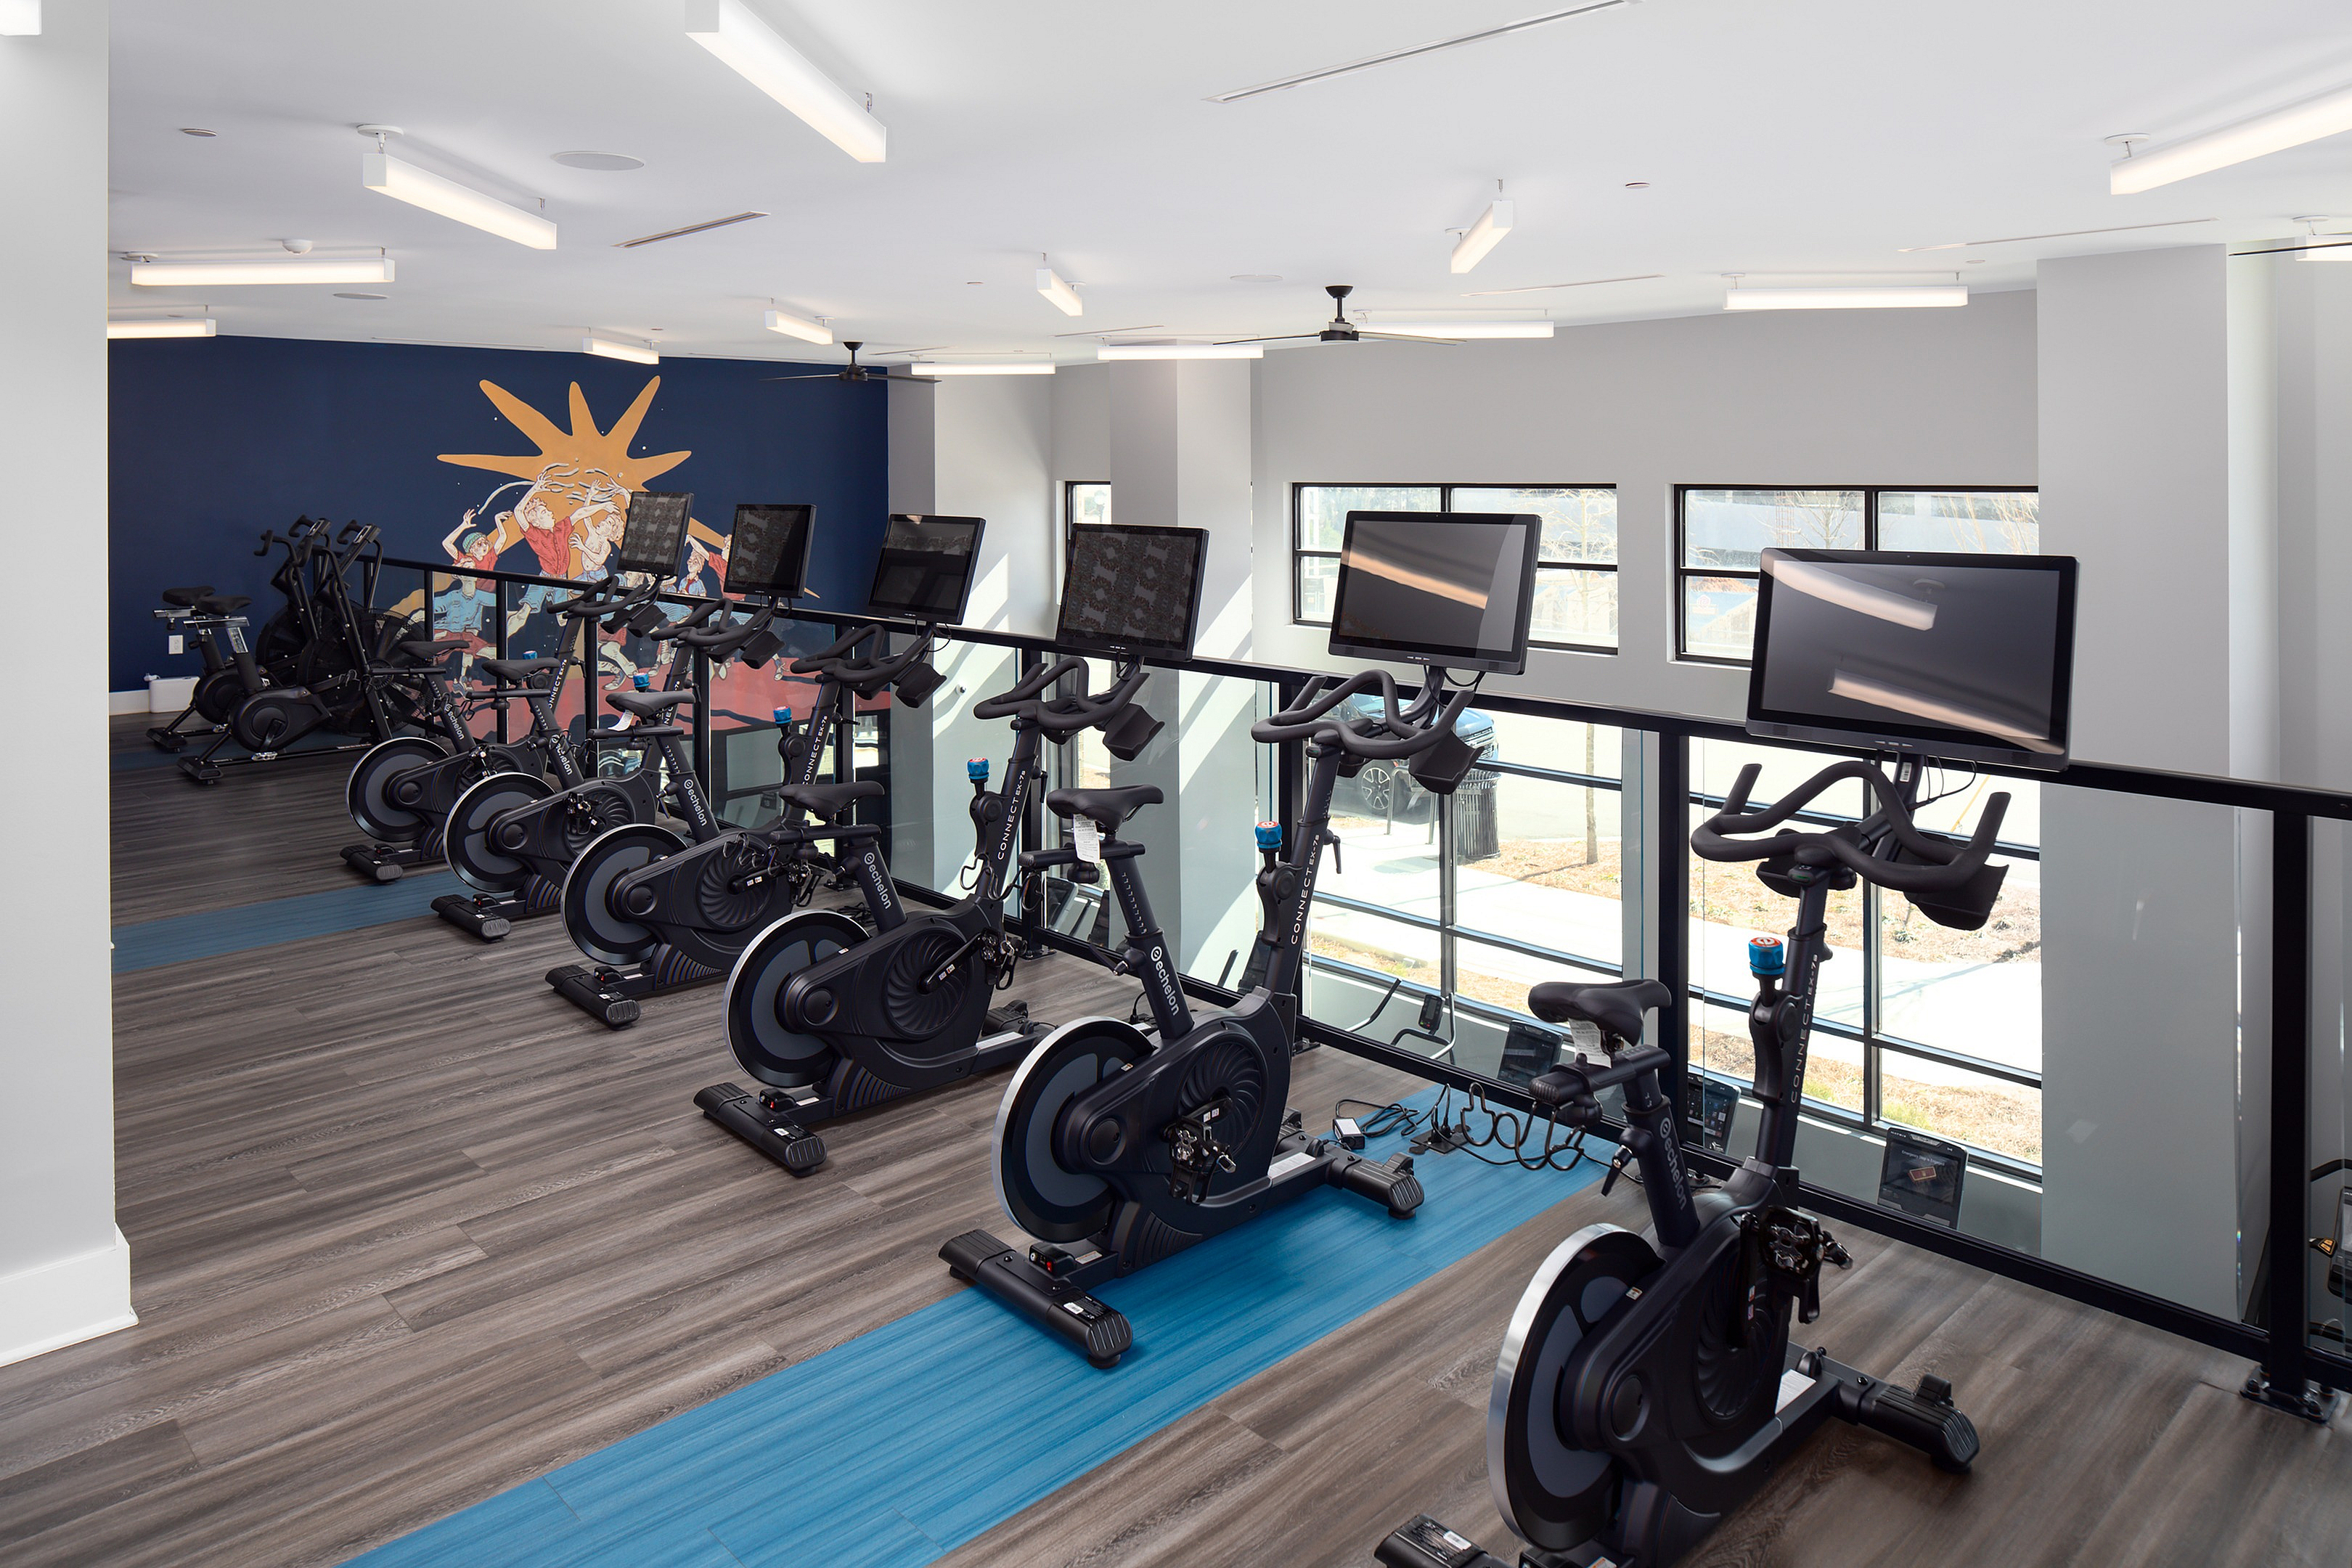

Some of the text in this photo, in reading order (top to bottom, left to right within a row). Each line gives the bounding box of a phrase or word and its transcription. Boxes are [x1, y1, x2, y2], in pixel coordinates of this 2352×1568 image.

[548, 676, 562, 709] ONNECT
[801, 737, 822, 785] ONNECT
[687, 789, 708, 826] echelon
[997, 797, 1019, 860] CONNECT
[869, 864, 891, 910] echelon
[1291, 867, 1313, 944] CONNECT
[1156, 960, 1179, 1016] echelon
[1791, 999, 1811, 1103] CONNECT
[1665, 1138, 1687, 1211] echelon
